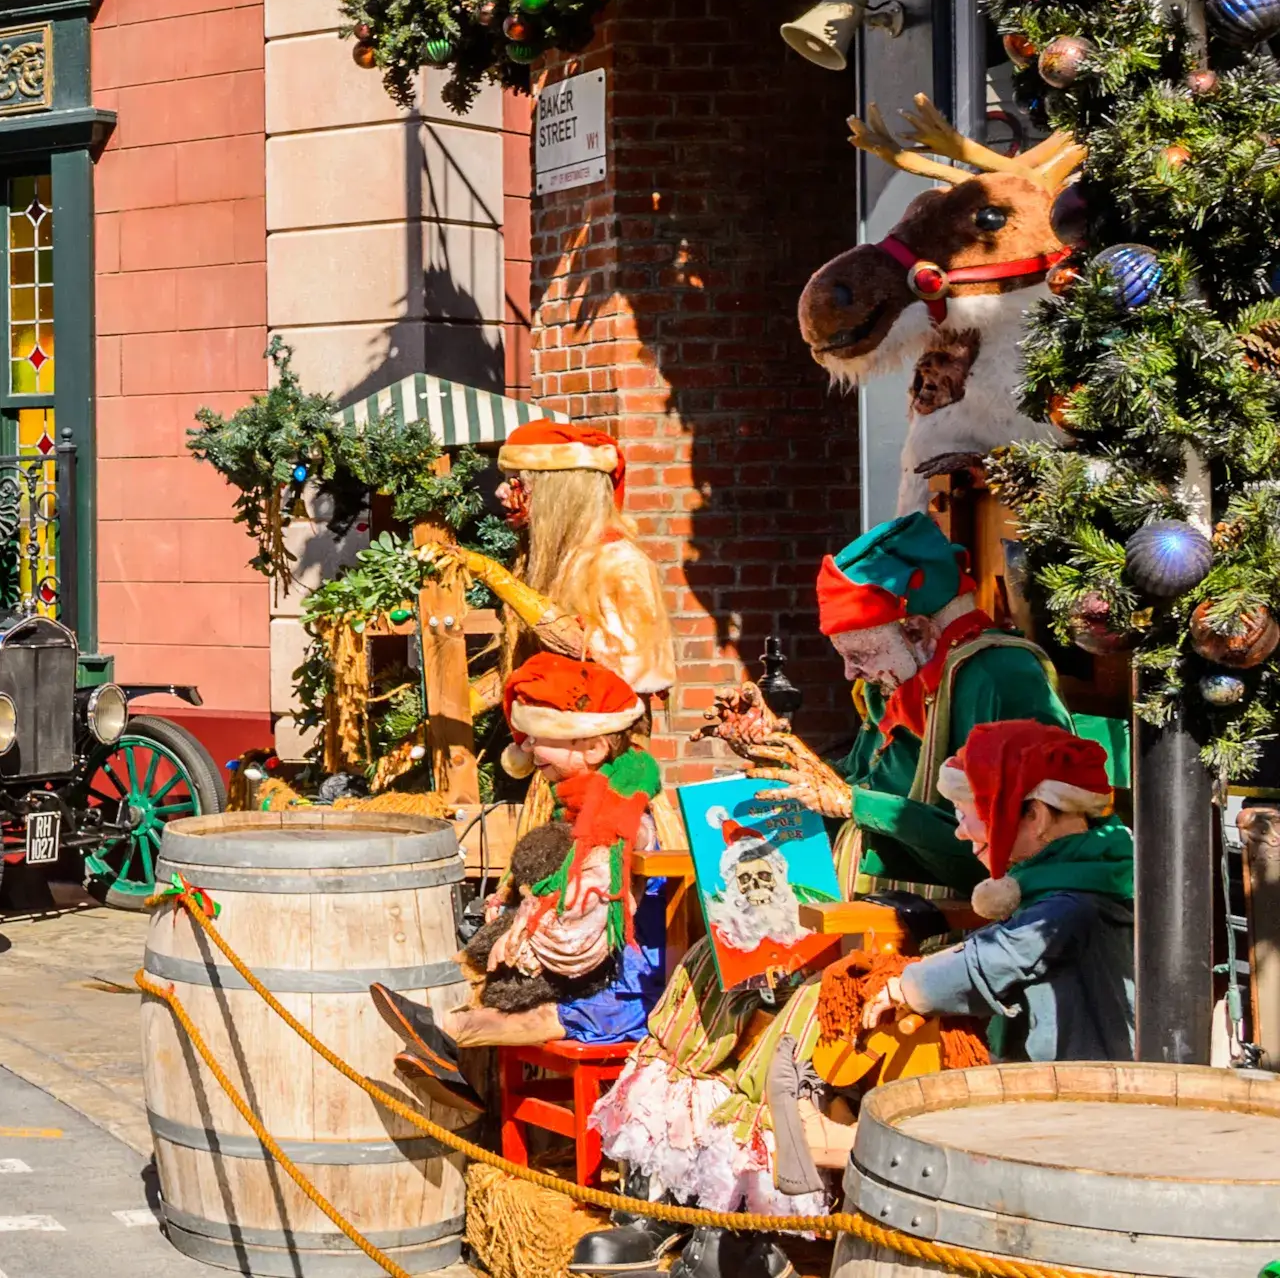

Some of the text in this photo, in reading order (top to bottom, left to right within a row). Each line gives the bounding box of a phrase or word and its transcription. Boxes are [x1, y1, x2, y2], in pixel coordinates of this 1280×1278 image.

[540, 90, 574, 120] BAKER
[540, 116, 578, 147] STREET
[586, 131, 599, 150] W1
[36, 816, 52, 838] RH
[31, 837, 54, 860] 1027
